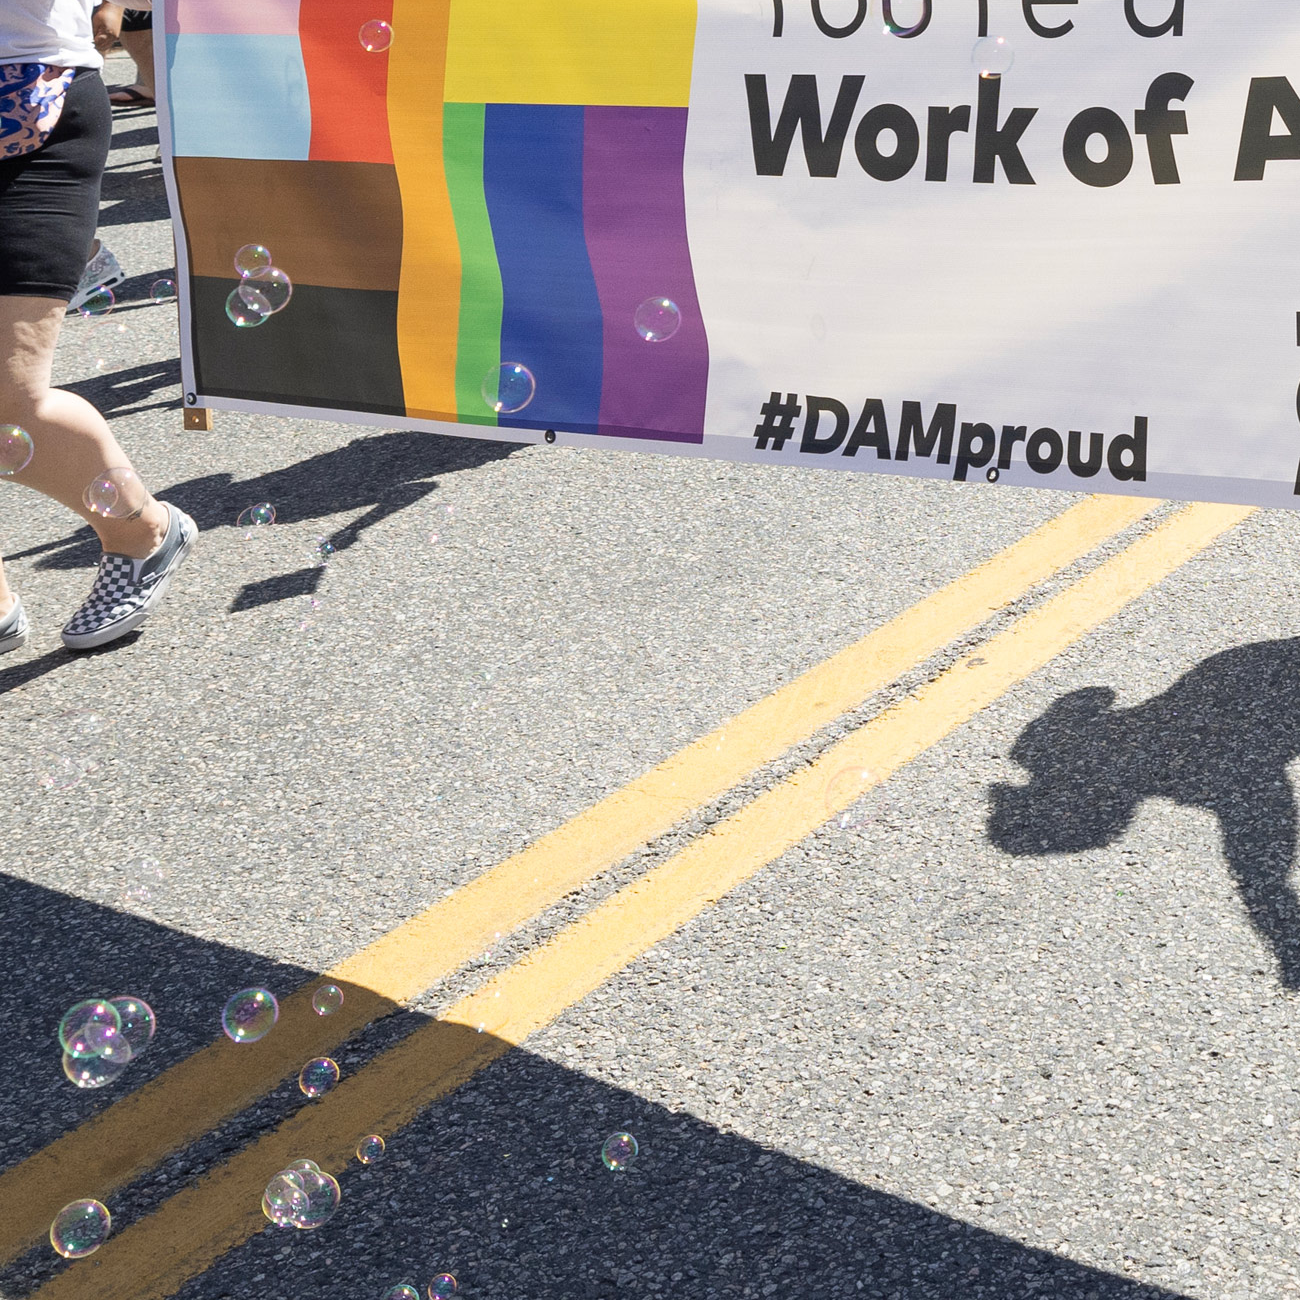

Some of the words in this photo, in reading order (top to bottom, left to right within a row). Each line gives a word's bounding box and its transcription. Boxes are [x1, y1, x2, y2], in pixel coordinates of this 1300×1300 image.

[744, 72, 1039, 185] Work
[1062, 72, 1195, 188] of
[753, 392, 1148, 483] #DAMproud
